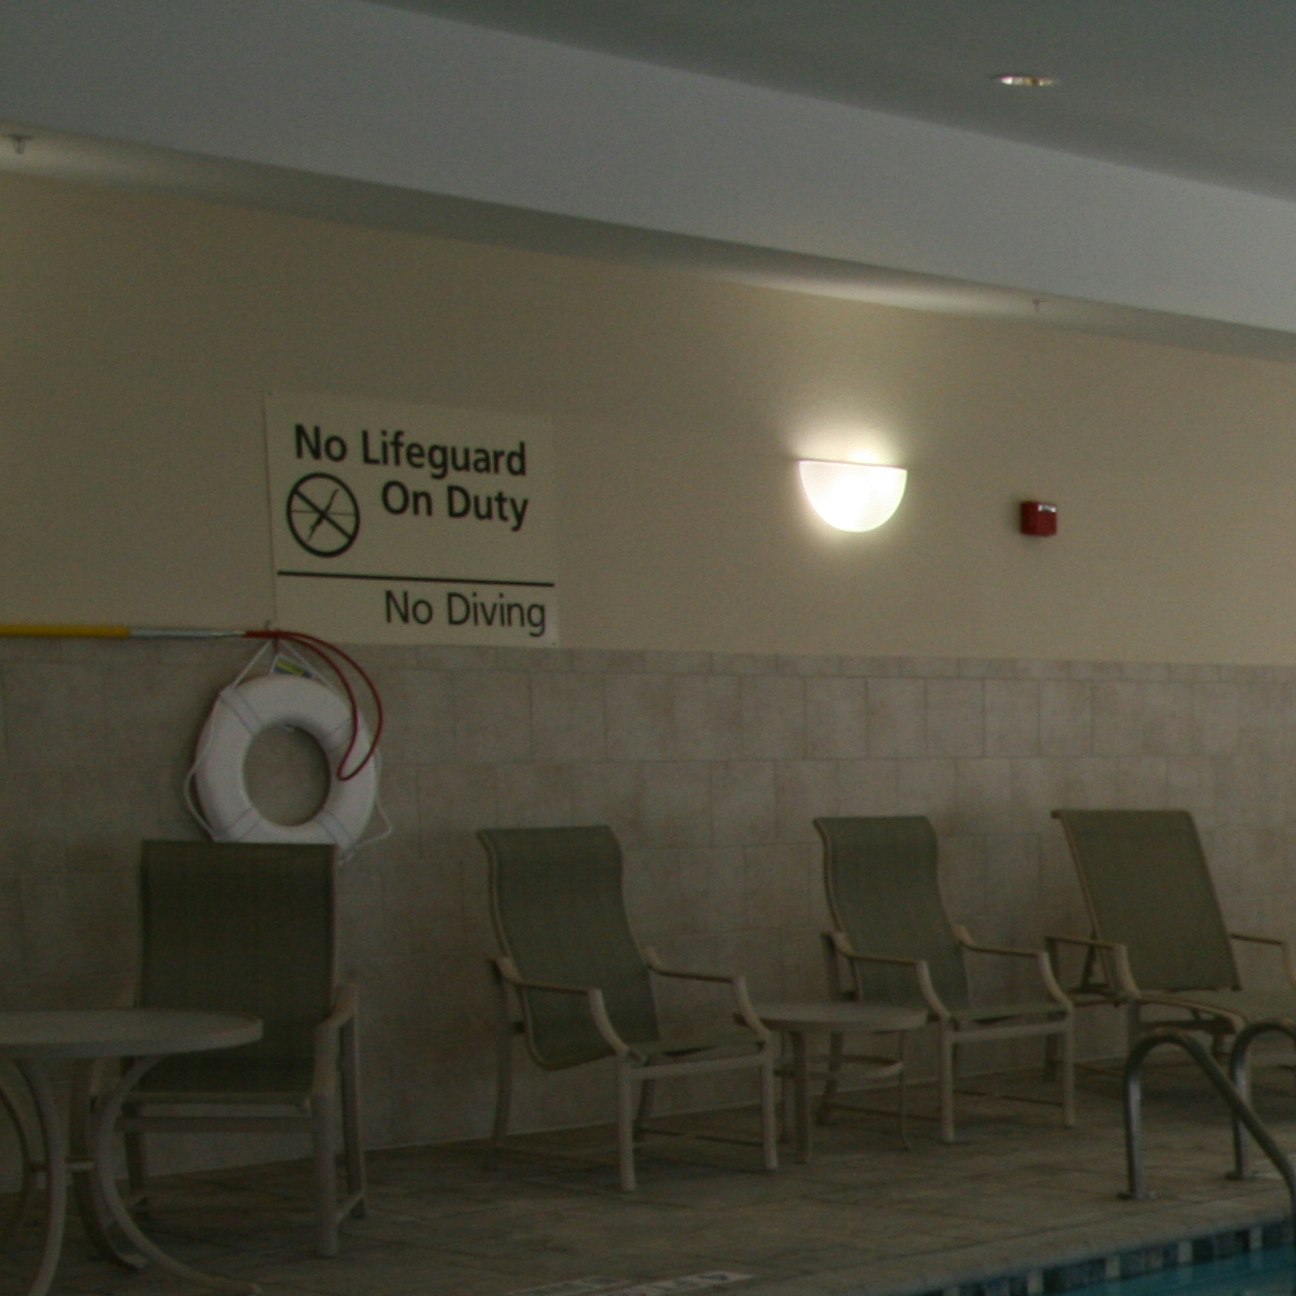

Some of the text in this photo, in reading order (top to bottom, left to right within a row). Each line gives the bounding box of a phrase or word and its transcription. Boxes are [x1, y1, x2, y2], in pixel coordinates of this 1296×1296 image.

[294, 423, 527, 480] No Lifeguard
[381, 480, 529, 532] On Duty
[384, 590, 546, 638] No Diving
